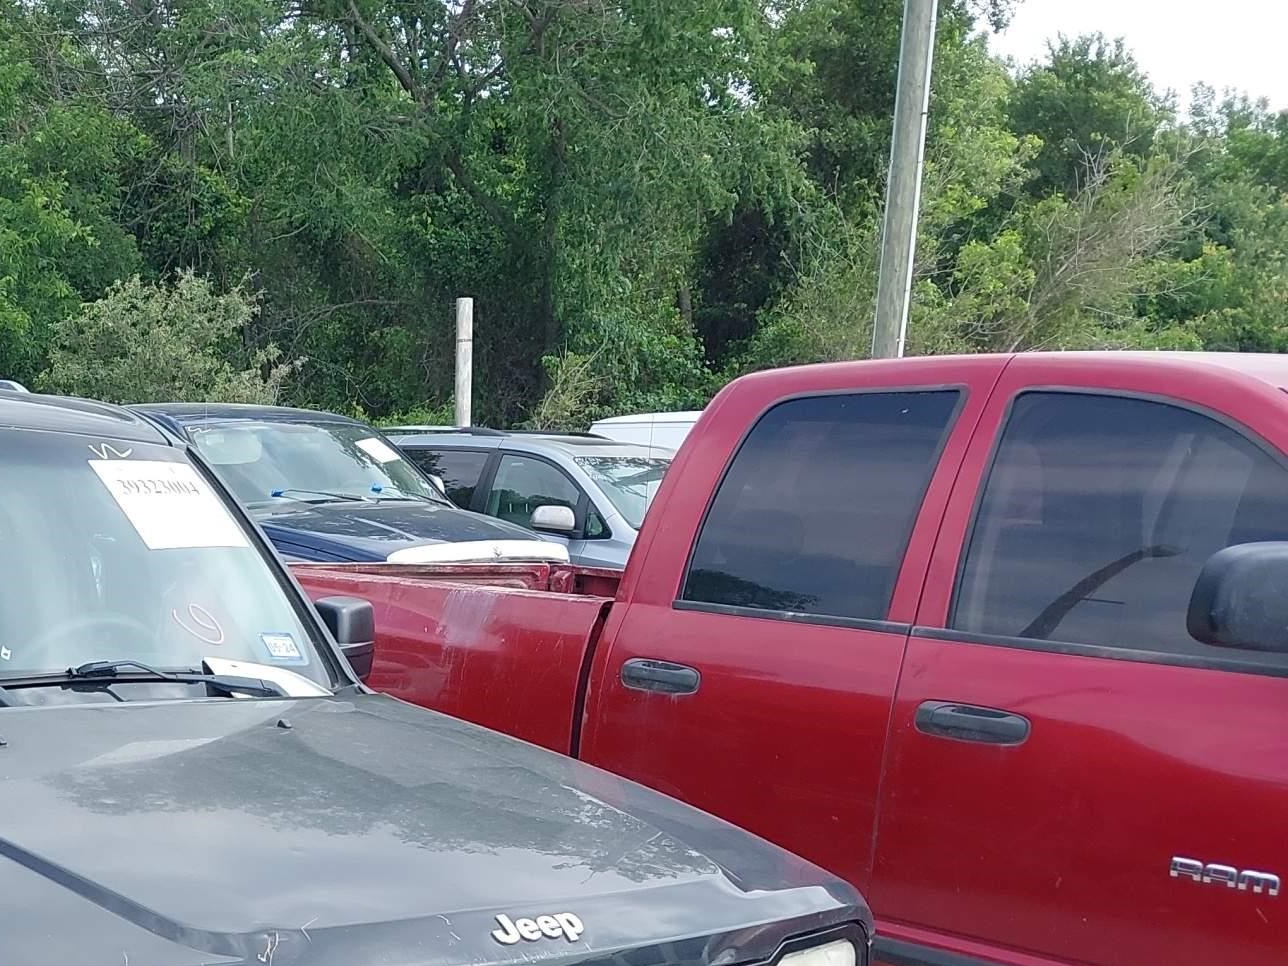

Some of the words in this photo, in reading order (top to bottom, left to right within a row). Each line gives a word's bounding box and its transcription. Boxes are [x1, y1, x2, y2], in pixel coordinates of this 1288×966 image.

[115, 479, 201, 496] 39323004
[1169, 856, 1280, 896] RAM
[490, 911, 585, 945] Jeep
